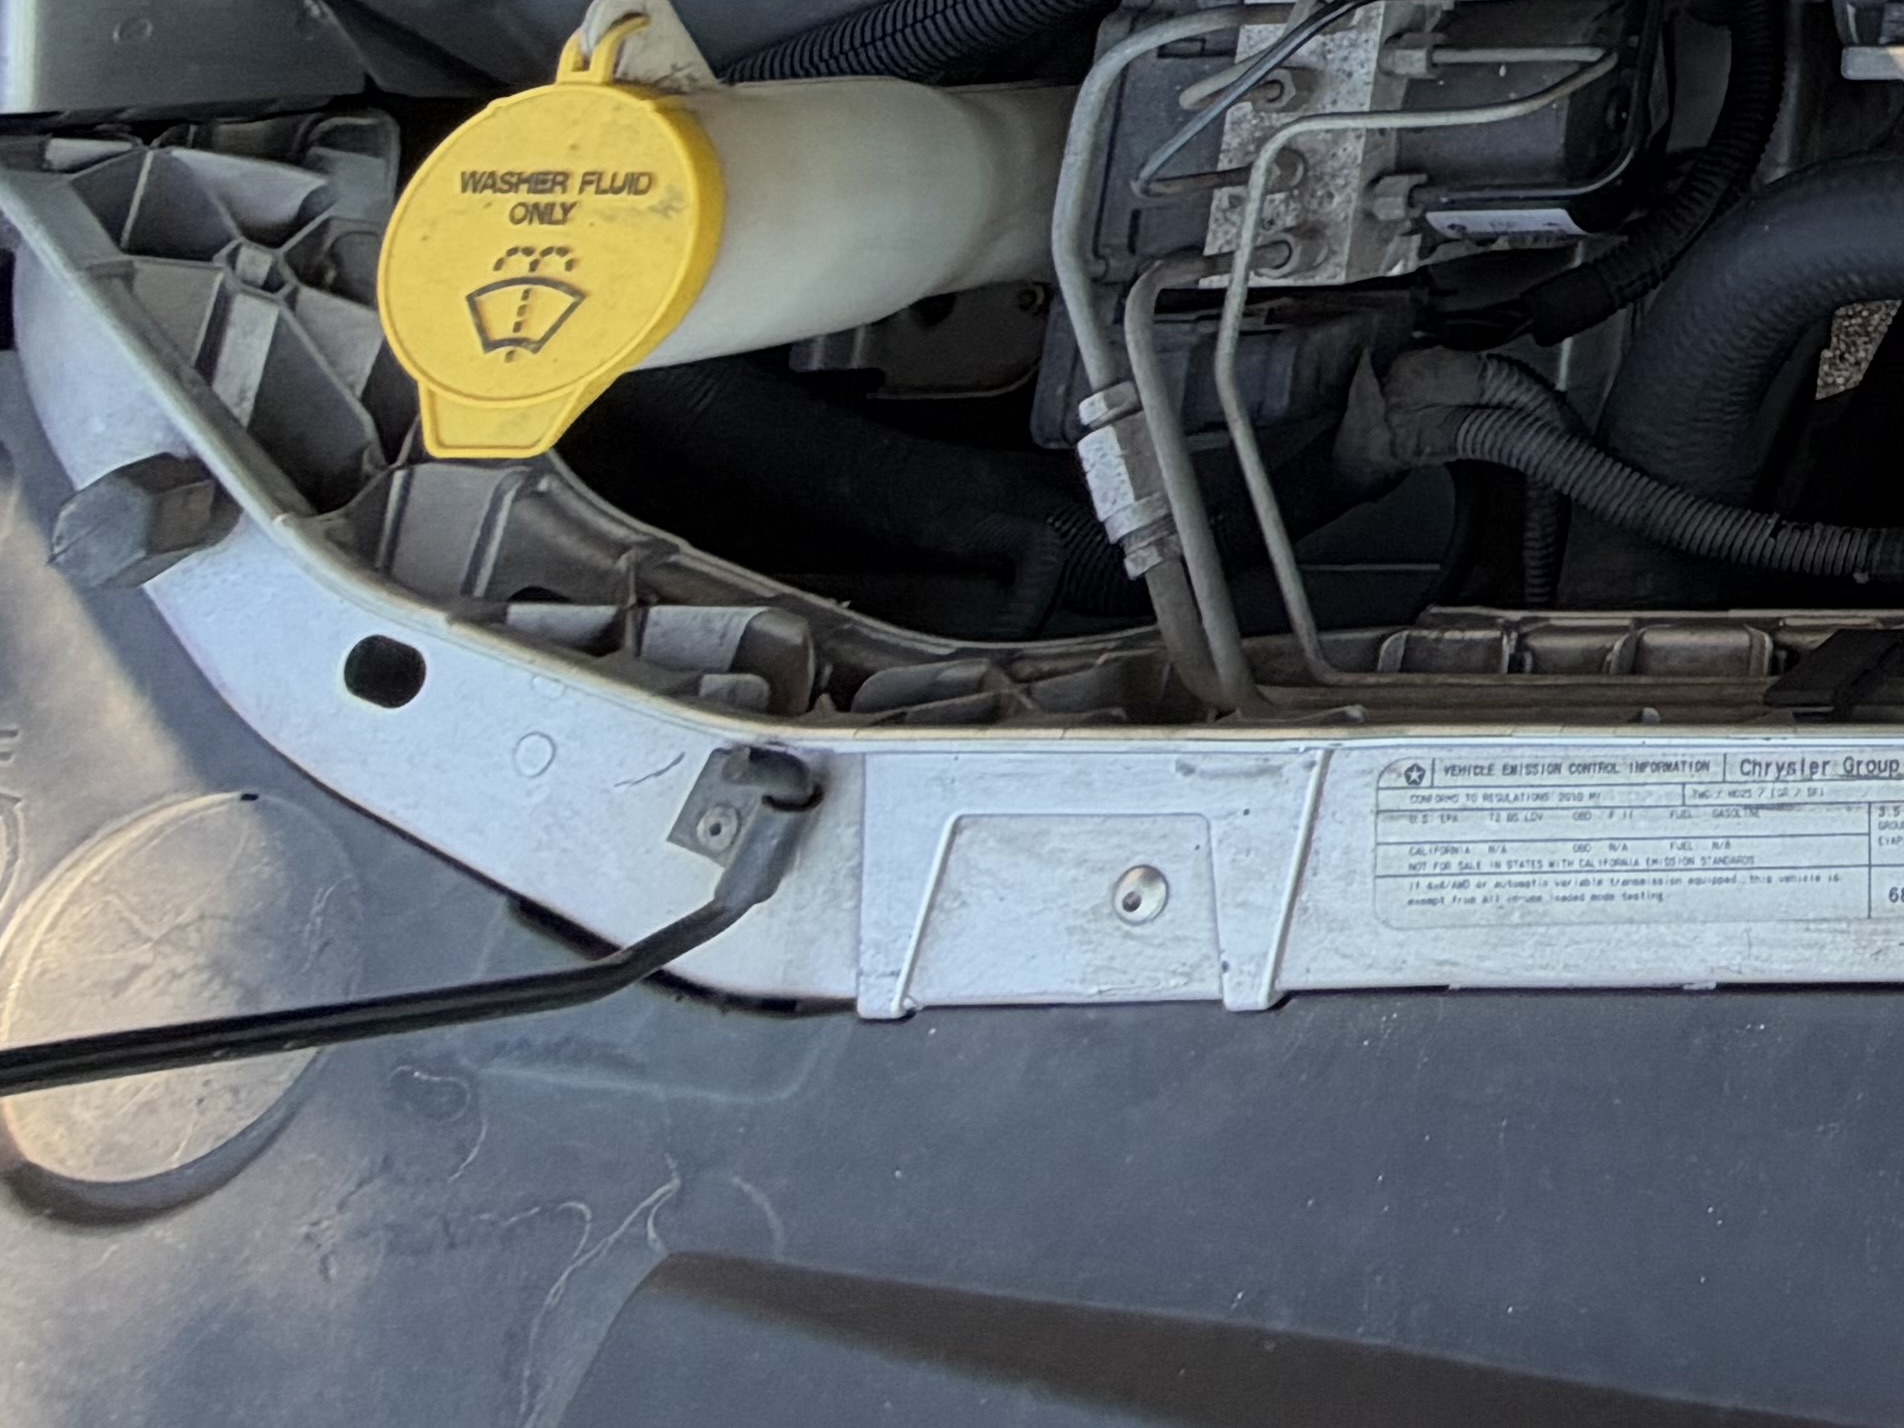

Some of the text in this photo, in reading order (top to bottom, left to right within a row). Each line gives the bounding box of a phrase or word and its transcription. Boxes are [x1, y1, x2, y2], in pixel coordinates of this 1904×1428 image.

[459, 170, 656, 195] WASHER FLUID
[508, 201, 578, 226] ONLY
[1443, 760, 1711, 777] VEHICLE EMISSION CONTROL INFORMATION
[1739, 756, 1831, 781] Chrysler
[1843, 755, 1900, 779] Group
